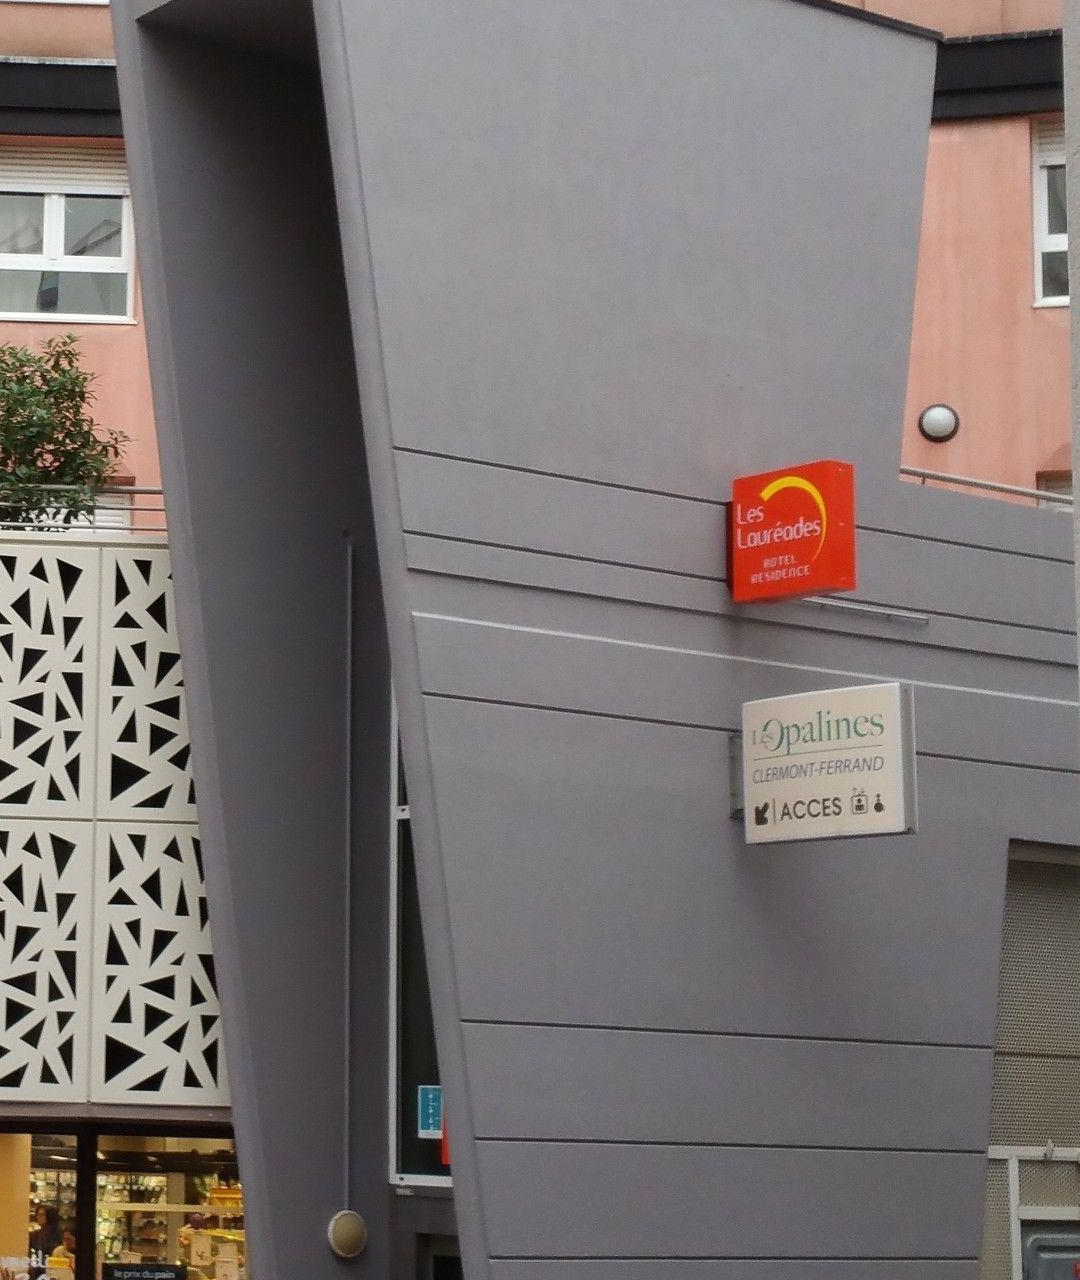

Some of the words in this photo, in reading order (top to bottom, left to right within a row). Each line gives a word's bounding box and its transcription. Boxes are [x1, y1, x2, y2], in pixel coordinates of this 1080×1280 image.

[736, 503, 764, 525] Les
[737, 516, 821, 550] Lauréades
[763, 554, 796, 569] HOTEL
[750, 565, 811, 584] RESIDENCE
[762, 709, 885, 756] Opalines
[752, 756, 885, 784] CLERMONT-FERRAND
[780, 796, 843, 820] ACCES
